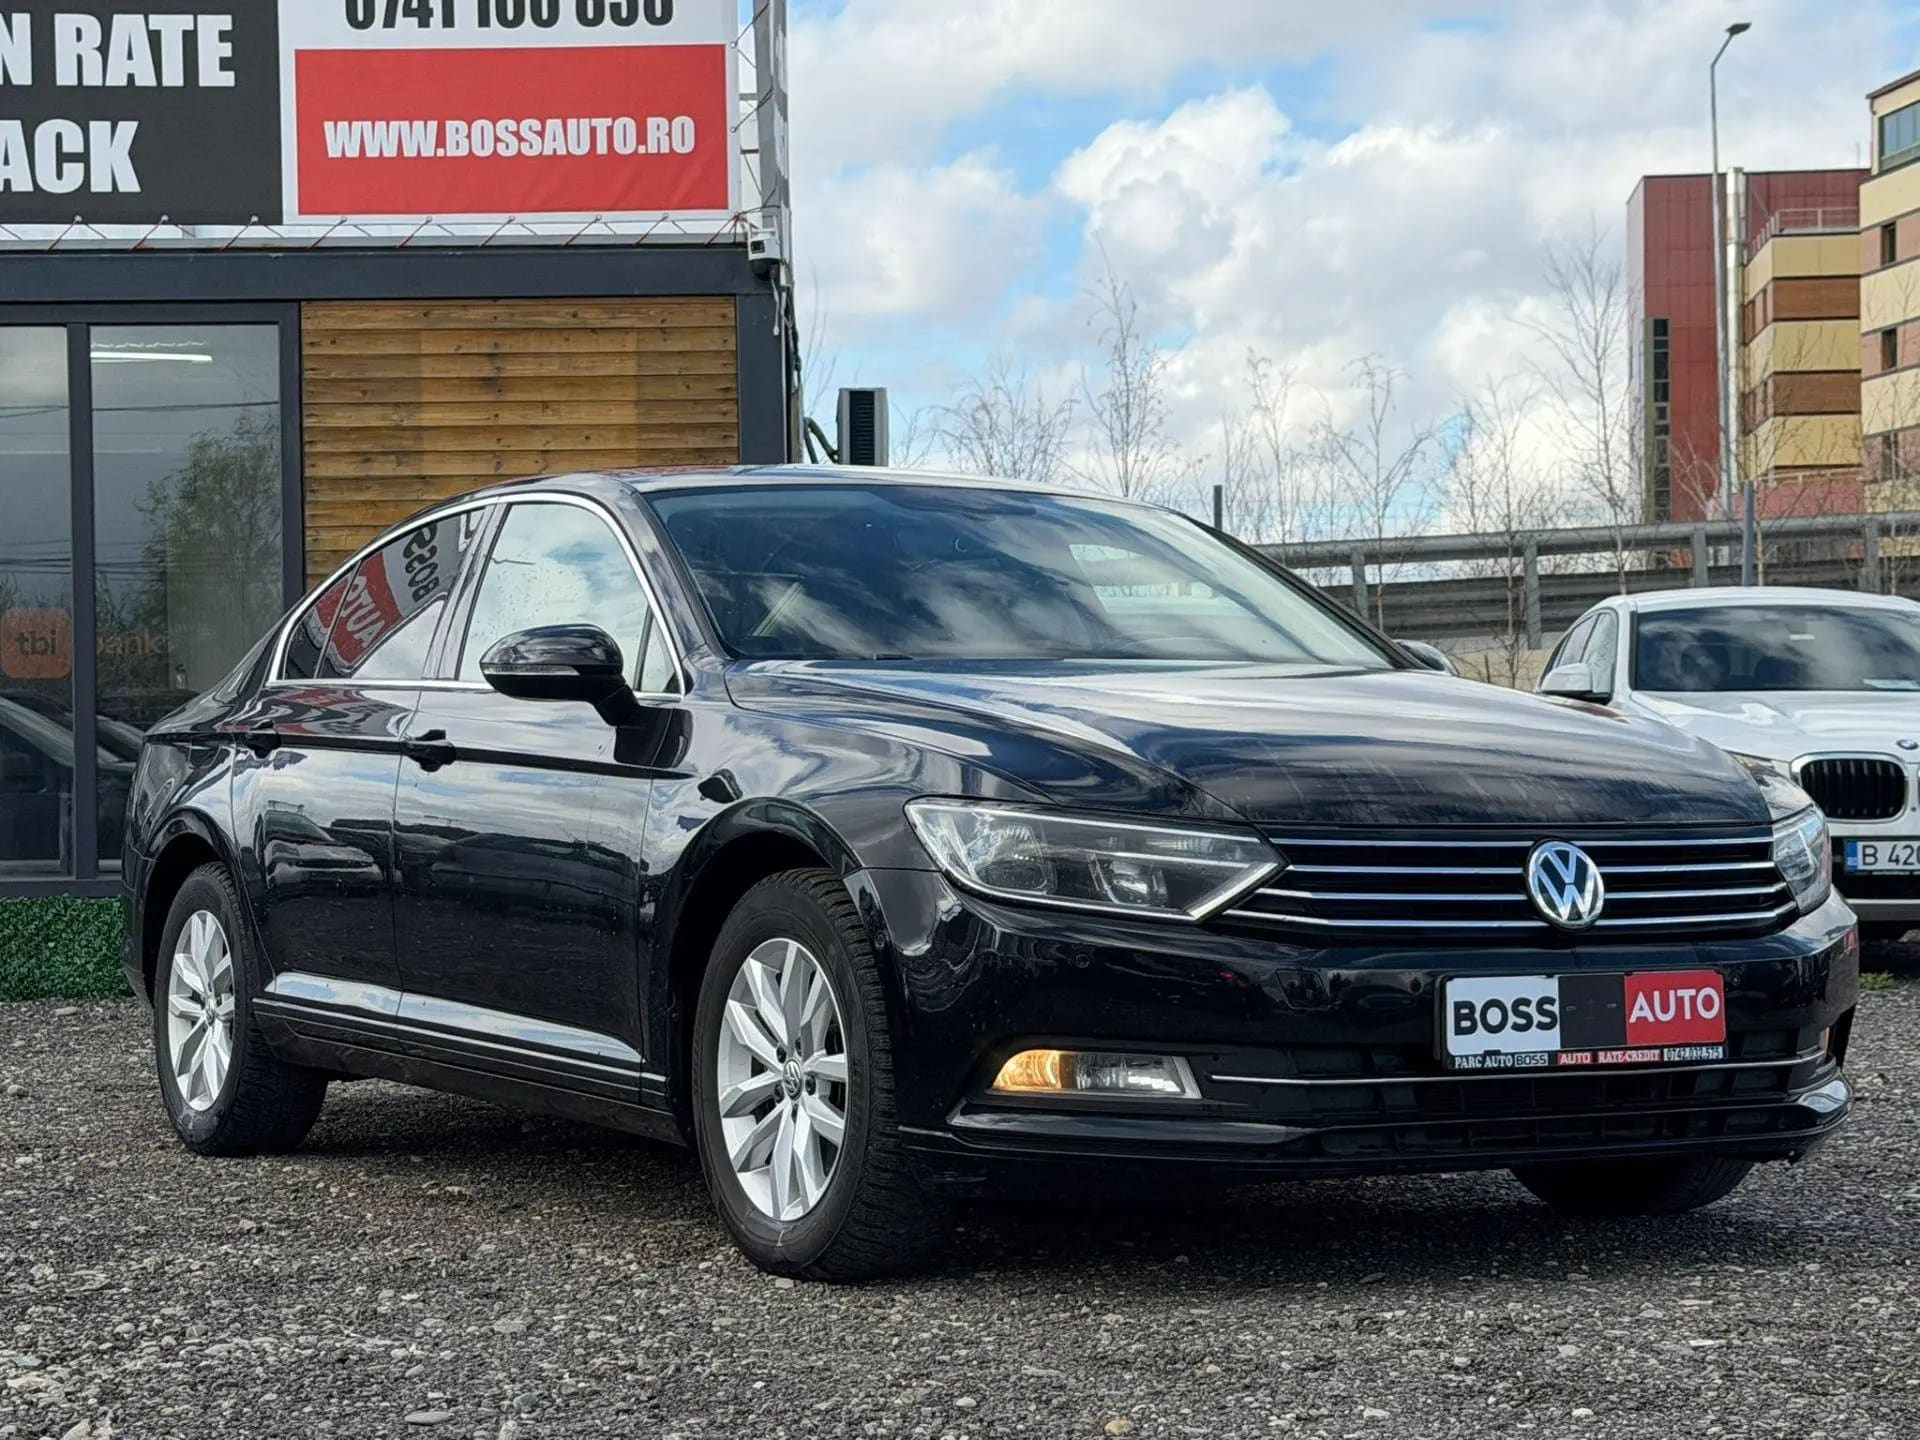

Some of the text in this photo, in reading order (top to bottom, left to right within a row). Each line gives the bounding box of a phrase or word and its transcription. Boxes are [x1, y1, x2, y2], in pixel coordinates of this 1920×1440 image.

[53, 12, 236, 87] RATE
[323, 115, 696, 158] WWW.BOSSAUTO.RO
[16, 629, 57, 655] tbi
[1862, 844, 1879, 866] B
[1453, 987, 1721, 1036] BOSS AUTO
[1454, 1056, 1483, 1069] PARC
[1484, 1054, 1513, 1068] AUTO
[1515, 1054, 1548, 1066] BOSS
[1560, 1052, 1592, 1065] AUTO
